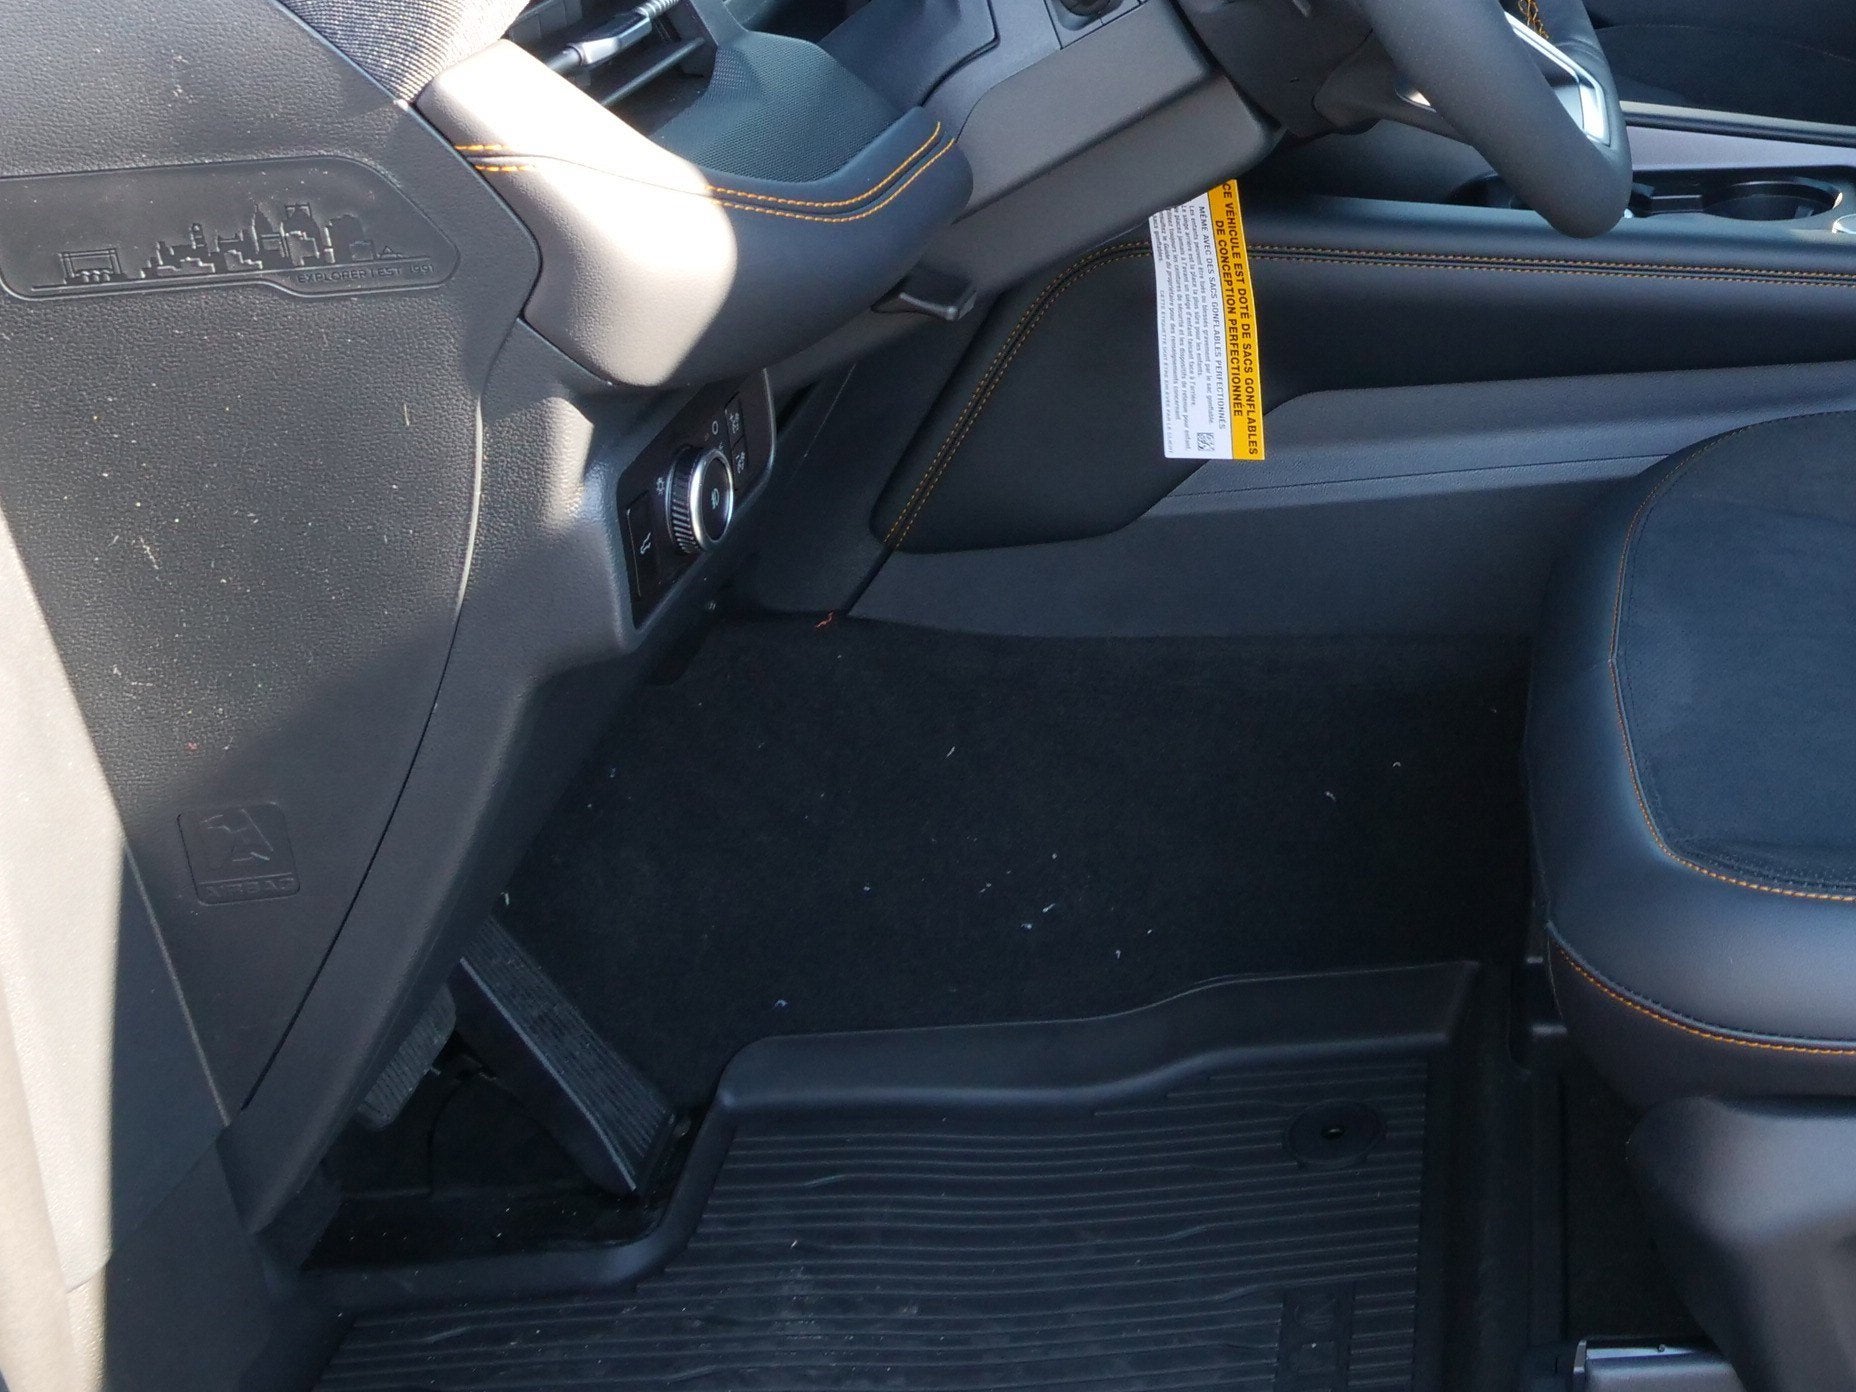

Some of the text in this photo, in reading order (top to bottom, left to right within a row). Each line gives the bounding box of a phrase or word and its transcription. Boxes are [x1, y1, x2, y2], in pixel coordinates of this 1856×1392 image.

[1222, 184, 1232, 198] CE
[1203, 235, 1211, 254] AVEC
[297, 269, 366, 284] EXPLORER
[1234, 263, 1244, 284] EST
[1209, 277, 1217, 298] SACS
[1238, 289, 1252, 319] DOTÉ
[1212, 302, 1221, 356] GONFLABLES
[1216, 221, 1244, 416] DE CONCEPTION PERFECTIONNÉE
[1242, 324, 1250, 338] DE
[1243, 344, 1252, 372] SACS
[1245, 378, 1258, 454] GONFLABLES
